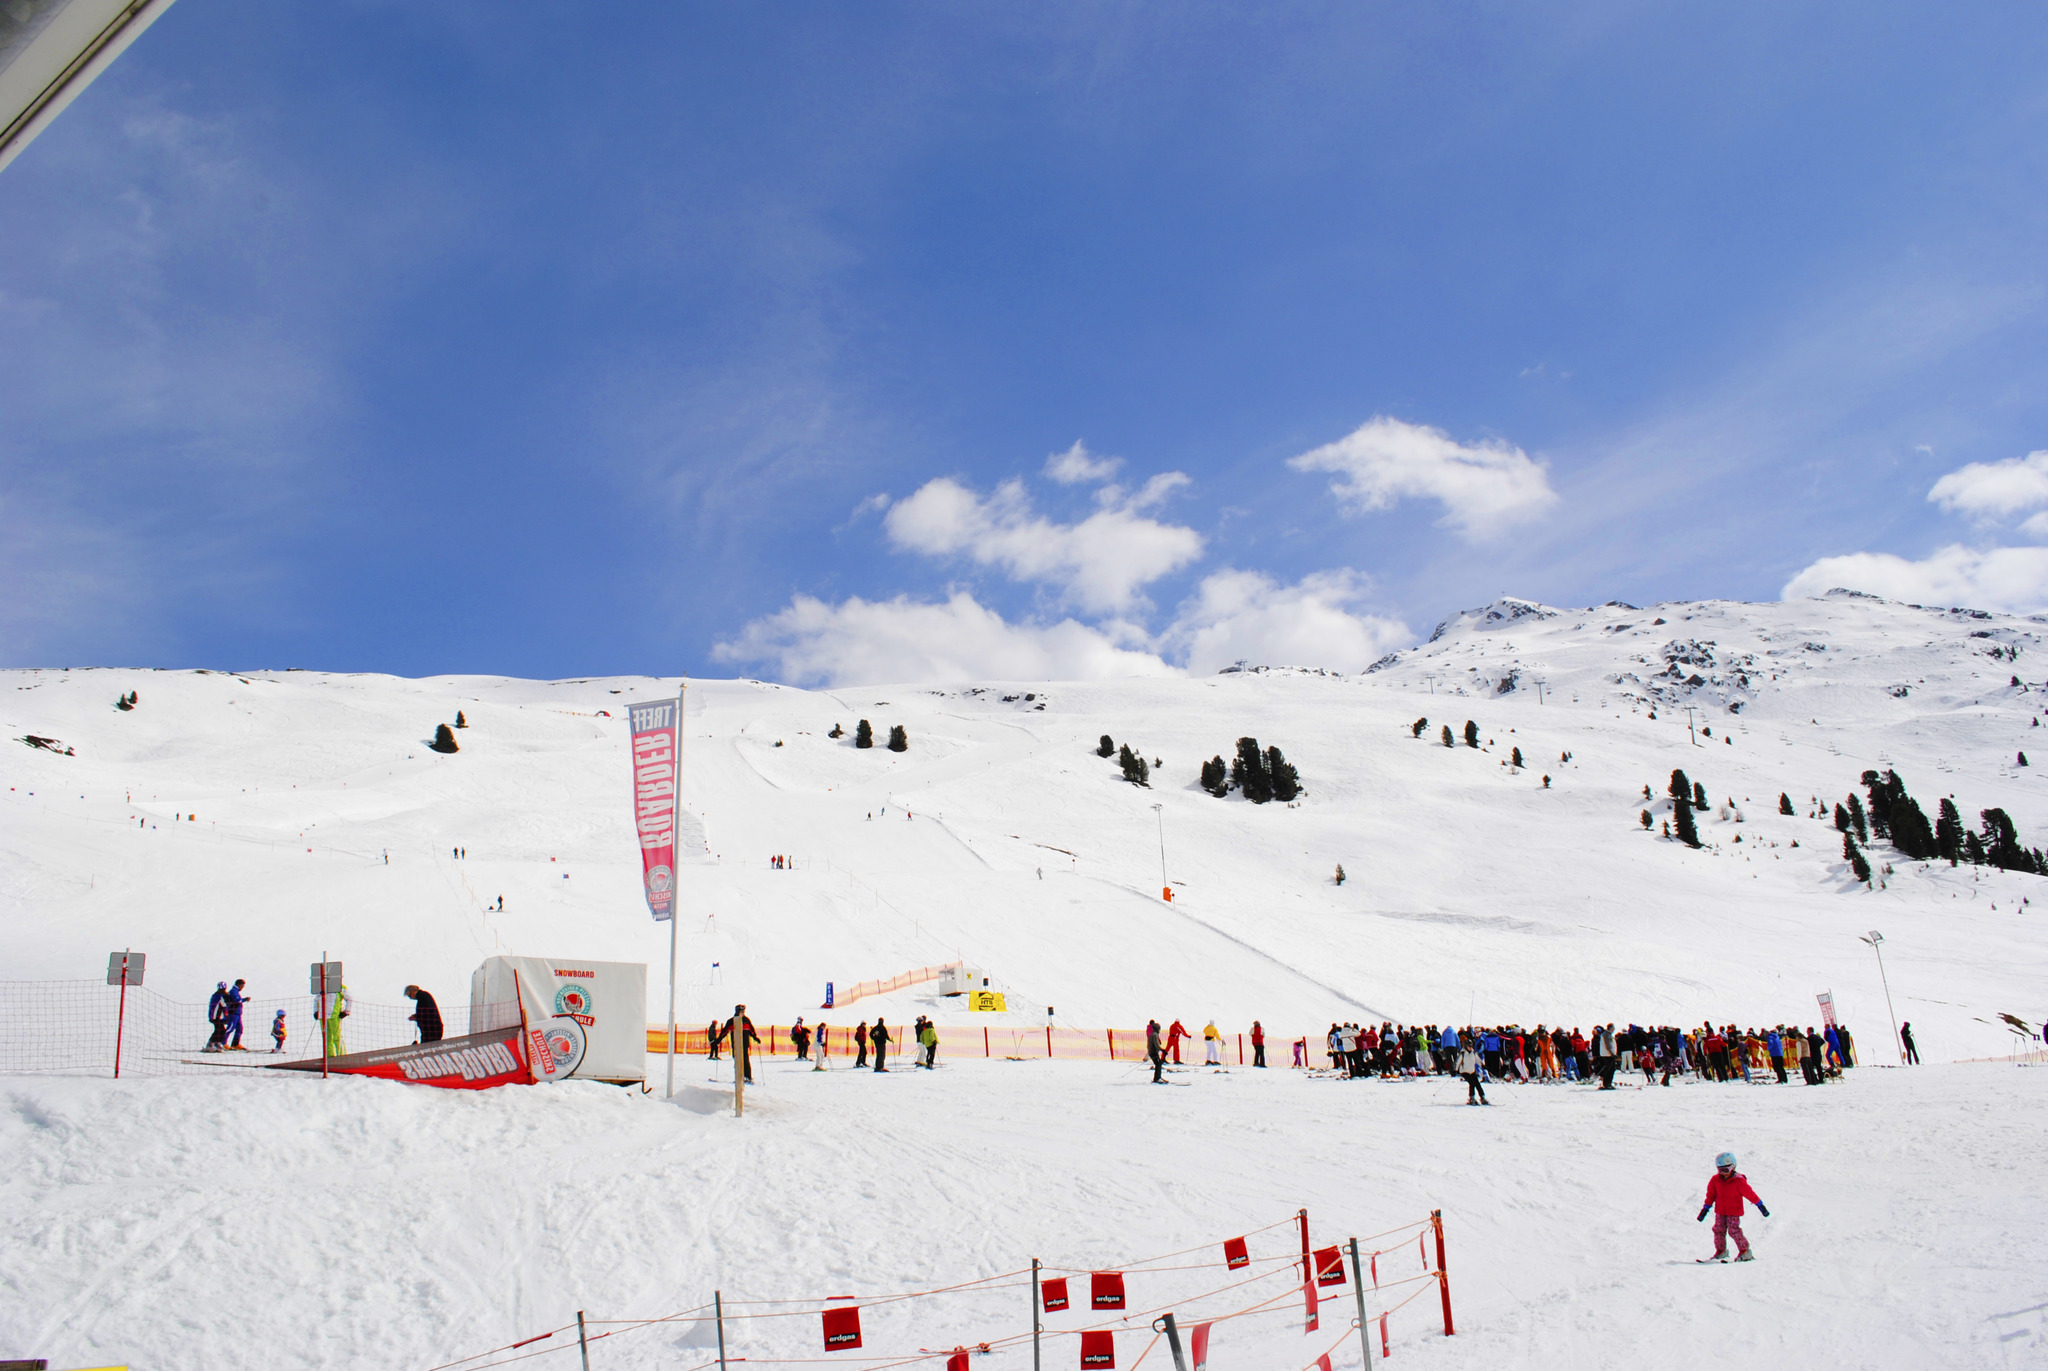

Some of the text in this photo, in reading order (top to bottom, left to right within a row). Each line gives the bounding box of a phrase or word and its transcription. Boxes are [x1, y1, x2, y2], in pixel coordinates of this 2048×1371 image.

[554, 969, 595, 979] SNOWBOARD
[1047, 1298, 1066, 1307] erdgas
[1096, 1295, 1120, 1303] erdgas
[829, 1334, 856, 1343] erdgas
[1085, 1355, 1110, 1363] erdgas
